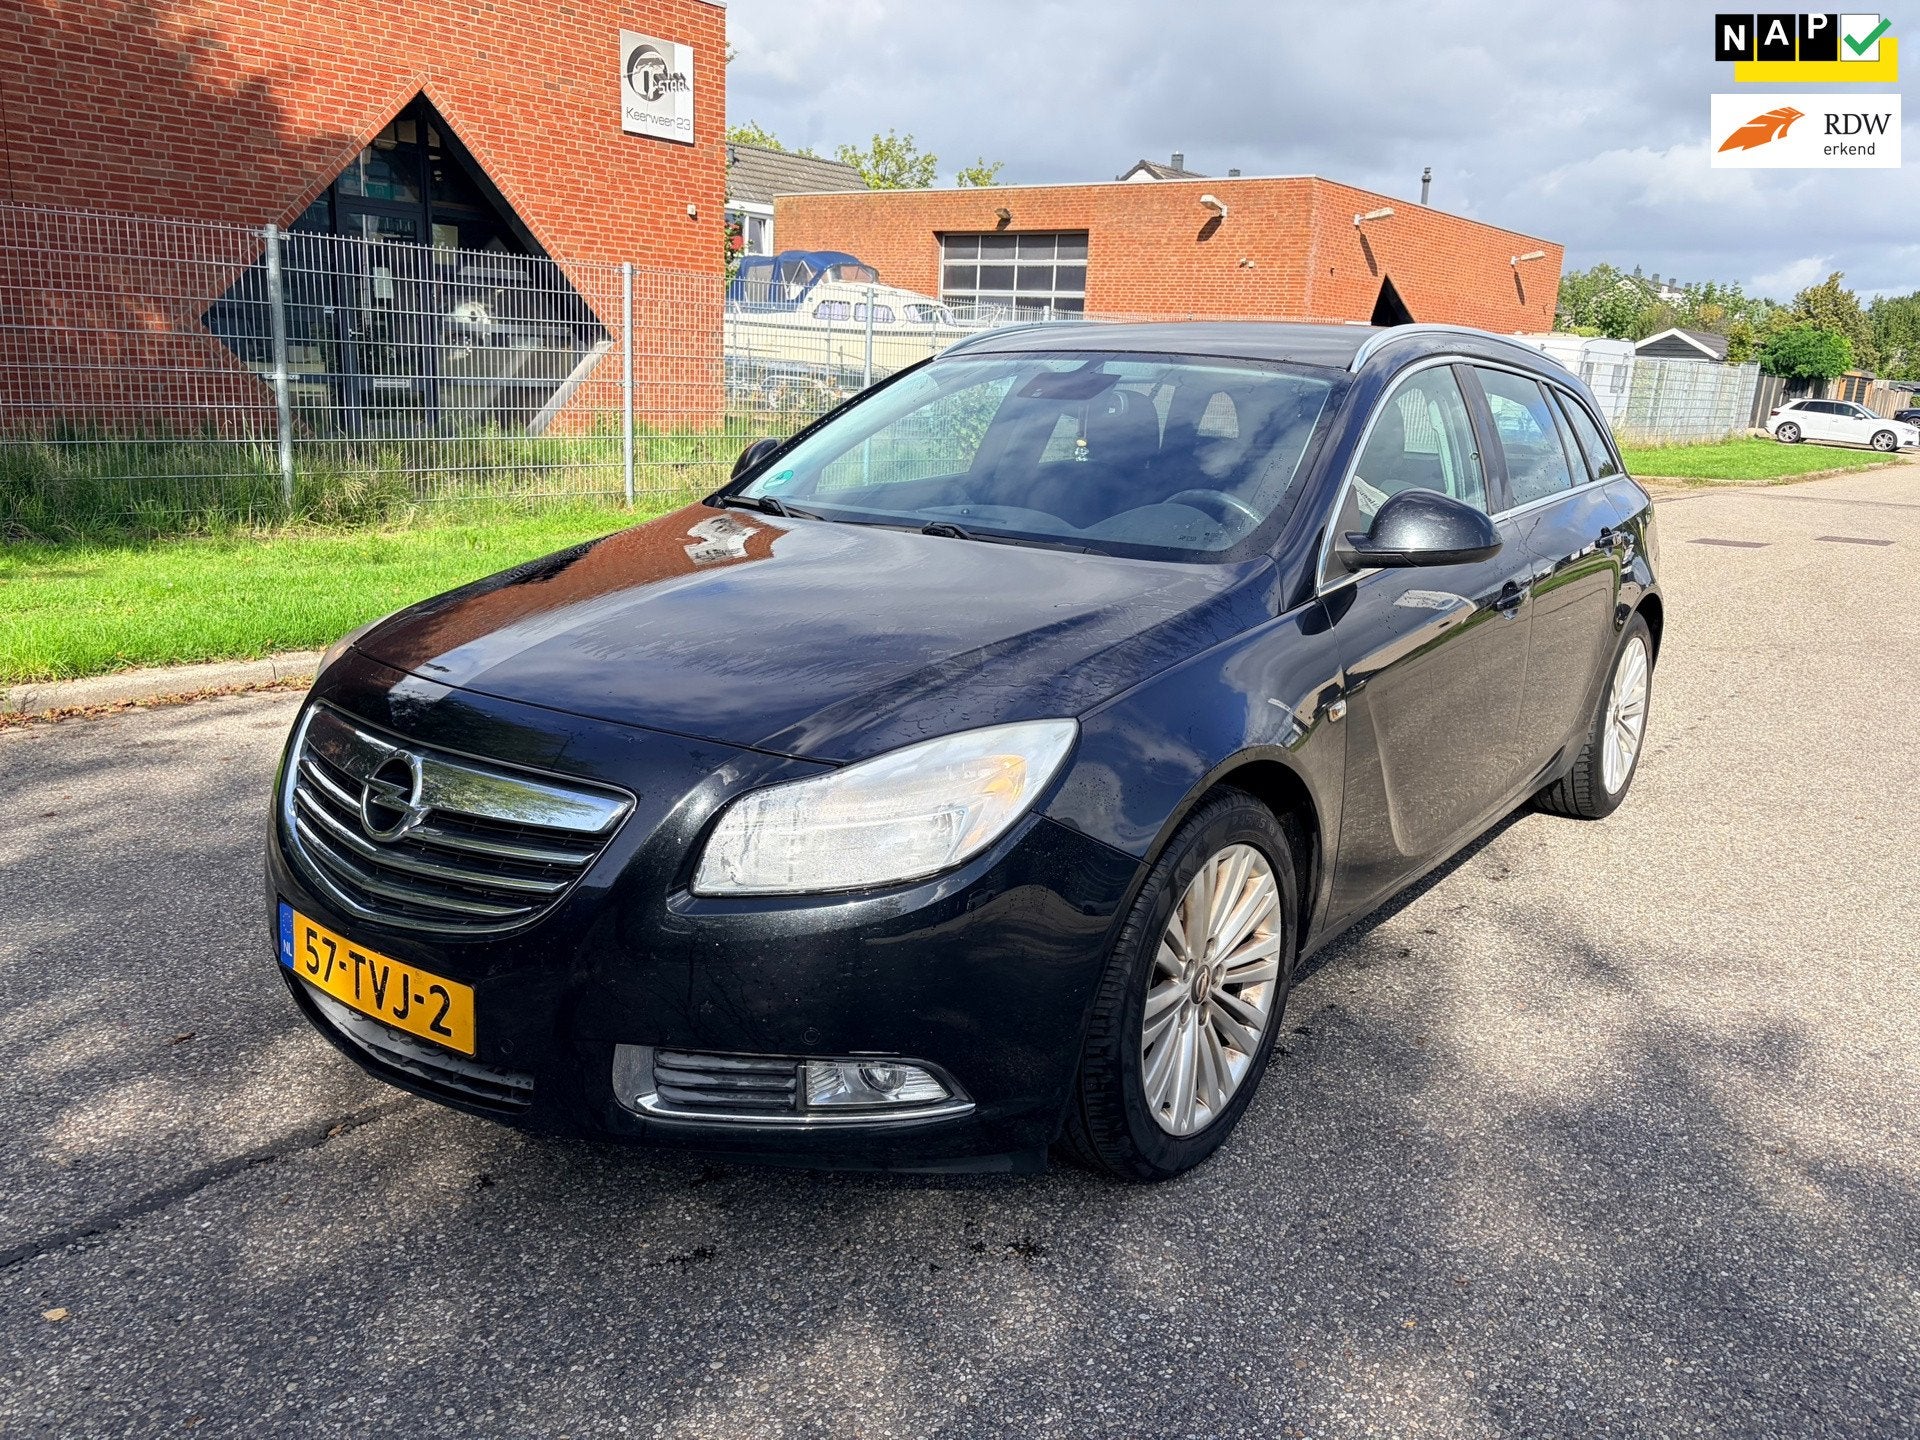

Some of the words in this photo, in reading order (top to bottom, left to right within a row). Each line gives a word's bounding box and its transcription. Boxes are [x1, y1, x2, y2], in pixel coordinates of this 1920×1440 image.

[626, 106, 675, 127] Keerweer
[676, 117, 691, 130] 23
[282, 939, 293, 957] NL
[305, 926, 452, 1037] 57-TVJ-2
